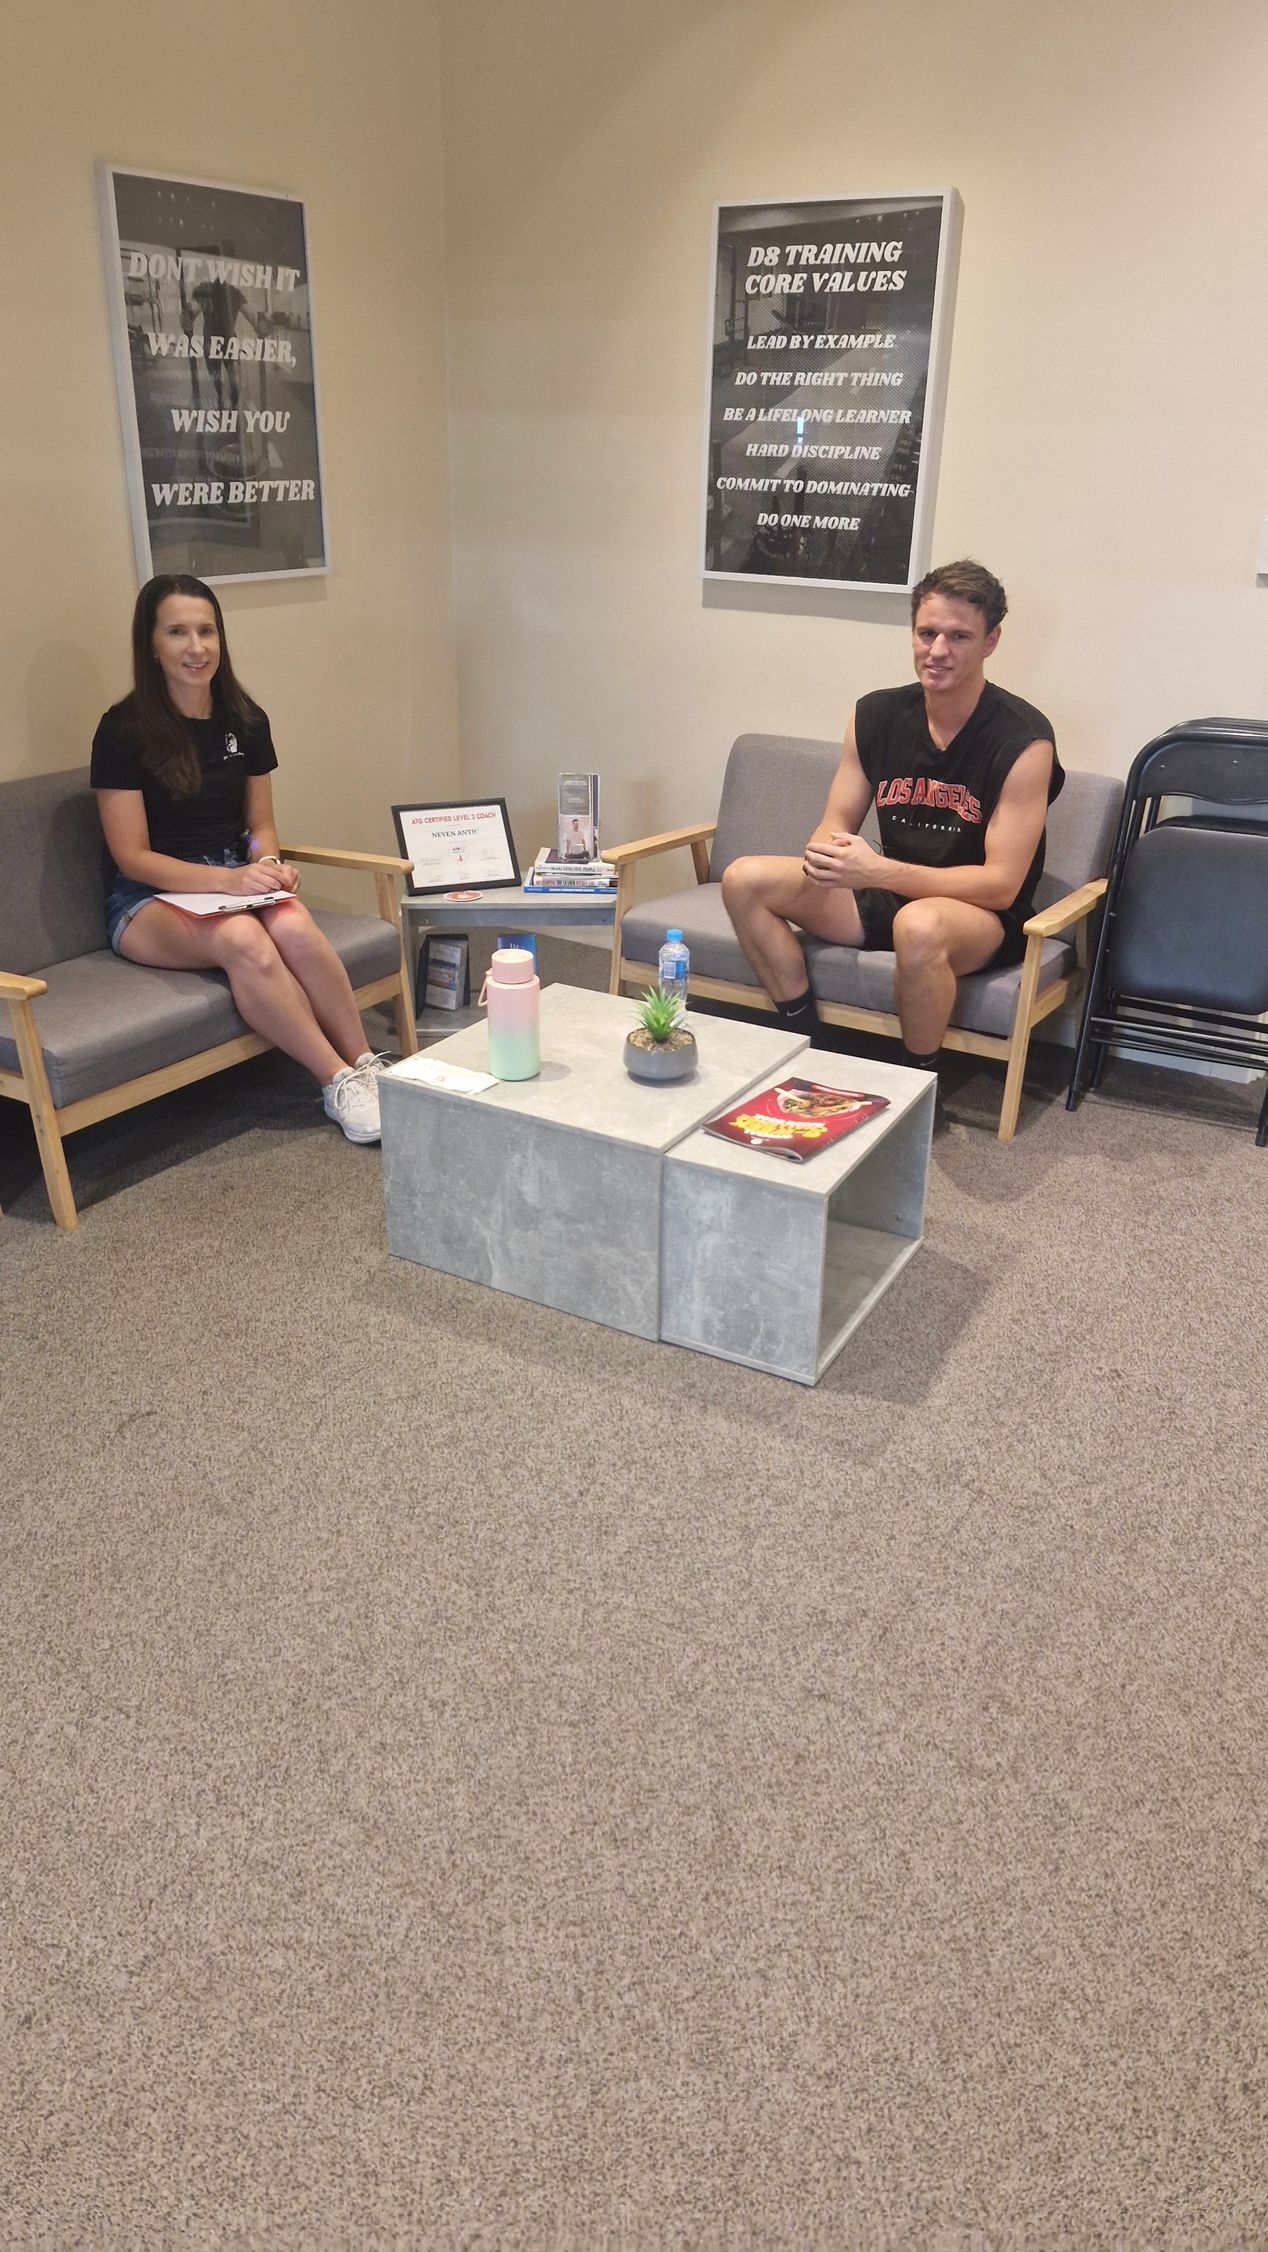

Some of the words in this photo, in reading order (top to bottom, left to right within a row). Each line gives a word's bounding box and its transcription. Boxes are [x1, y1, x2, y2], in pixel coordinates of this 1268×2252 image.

[746, 245, 781, 267] D8
[785, 241, 904, 265] TRAINING
[127, 252, 201, 282] DONT
[206, 259, 274, 290] WISH
[275, 265, 301, 292] IT
[744, 272, 807, 295] CORE
[811, 270, 907, 293] VALUES
[146, 333, 205, 359] WAS
[208, 336, 297, 367] EASIER,
[746, 334, 787, 349] LEAD
[788, 335, 815, 349] BY
[814, 334, 896, 349] EXAMPLE
[734, 371, 759, 386] DO
[760, 371, 793, 386] THE
[793, 372, 848, 386] RIGHT
[850, 372, 904, 387] THING
[170, 409, 238, 433] WISH
[243, 411, 291, 433] YOU
[723, 407, 744, 421] BE
[744, 408, 757, 421] A
[757, 408, 834, 423] LIFELONG
[835, 409, 912, 425] LEARNER
[745, 443, 788, 457] HARD
[790, 444, 882, 461] DISCIPLINE
[151, 481, 224, 506] WERE
[227, 478, 316, 505] BETTER
[716, 477, 781, 492] COMMIT
[782, 478, 804, 493] TO
[805, 480, 911, 498] DOMINATING
[756, 512, 781, 526] DO
[780, 514, 812, 528] ONE
[812, 515, 861, 531] MORE
[876, 777, 913, 807] LOS
[911, 777, 983, 824] ANGELES
[424, 816, 452, 824] CERTIFIED
[432, 830, 456, 838] NEVEN
